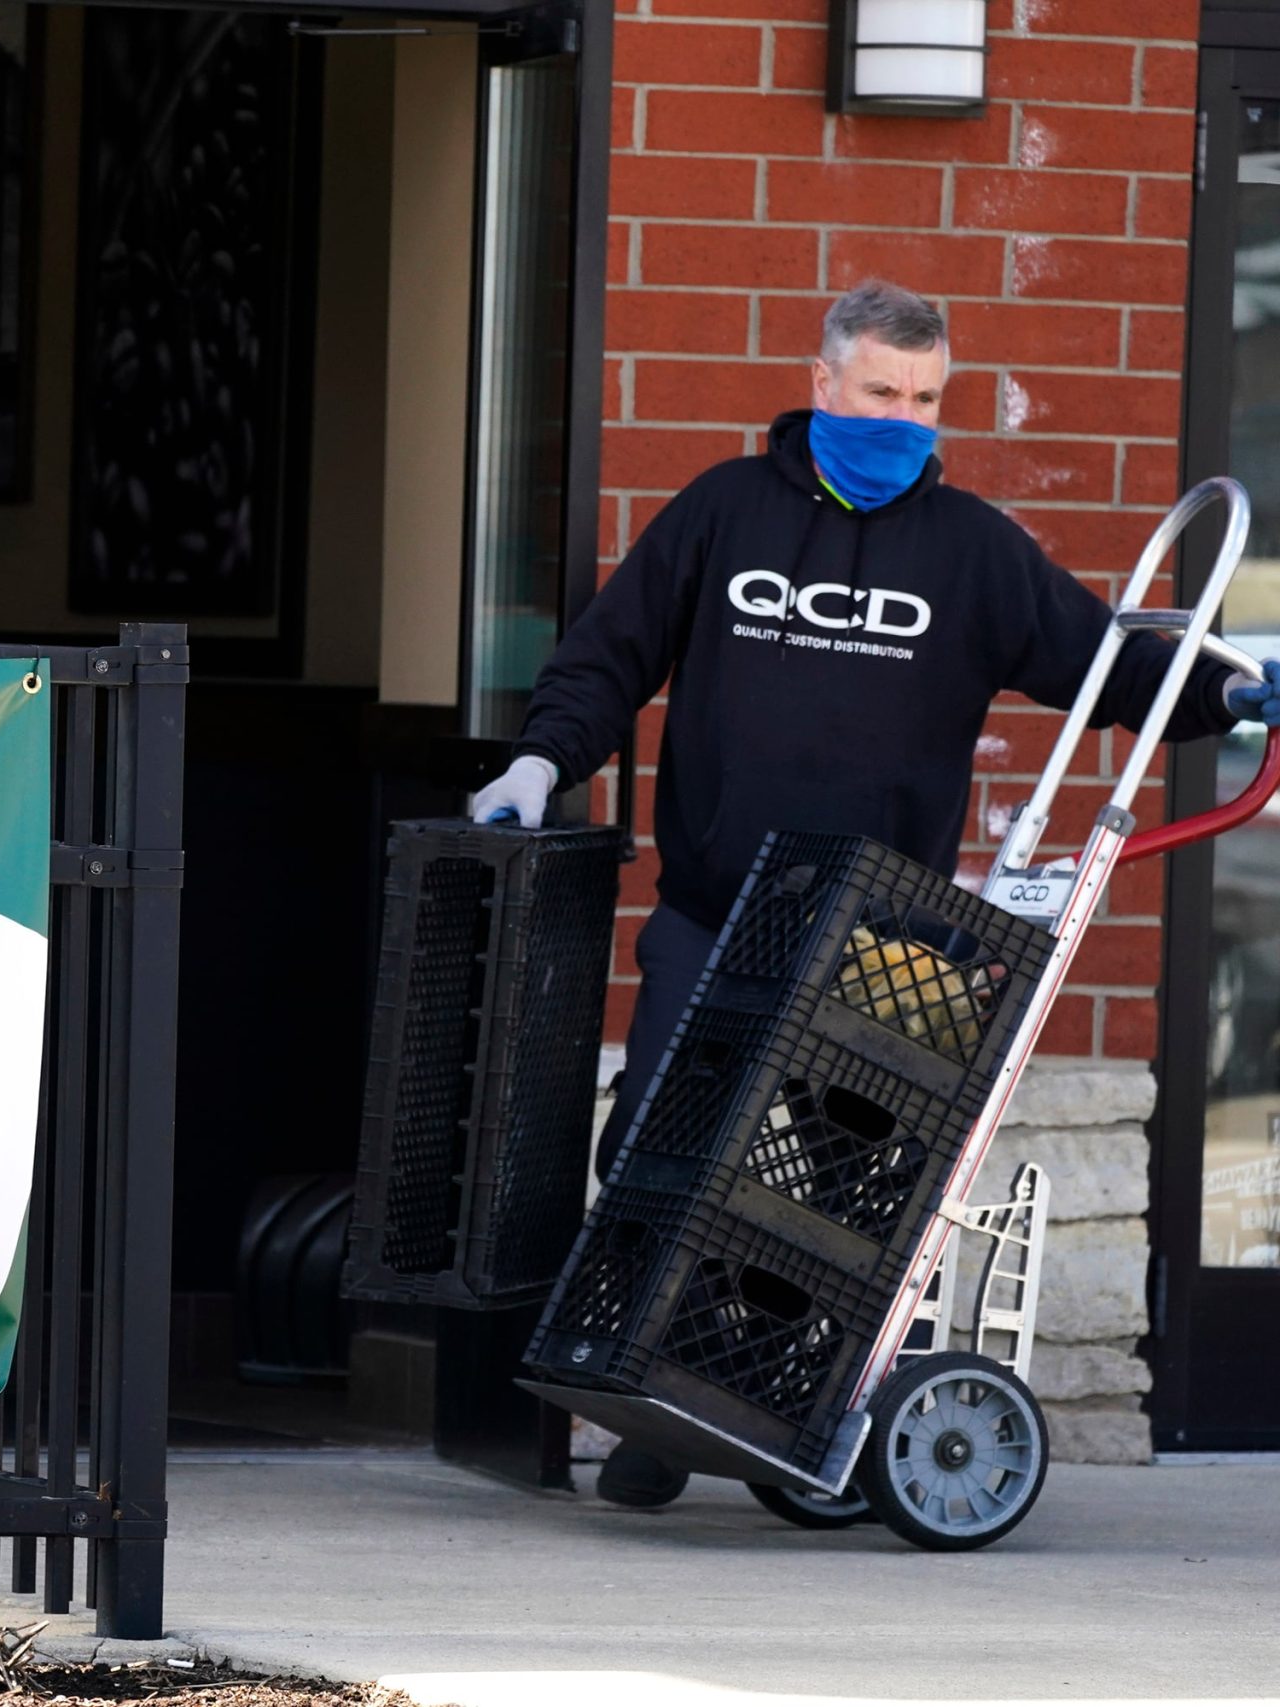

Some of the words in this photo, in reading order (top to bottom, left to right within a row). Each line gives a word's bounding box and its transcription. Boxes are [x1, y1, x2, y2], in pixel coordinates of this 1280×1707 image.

[728, 570, 931, 637] QCD
[733, 623, 781, 642] QUALITY
[833, 639, 913, 660] DISTRIBUTION
[1010, 885, 1049, 902] QCD
